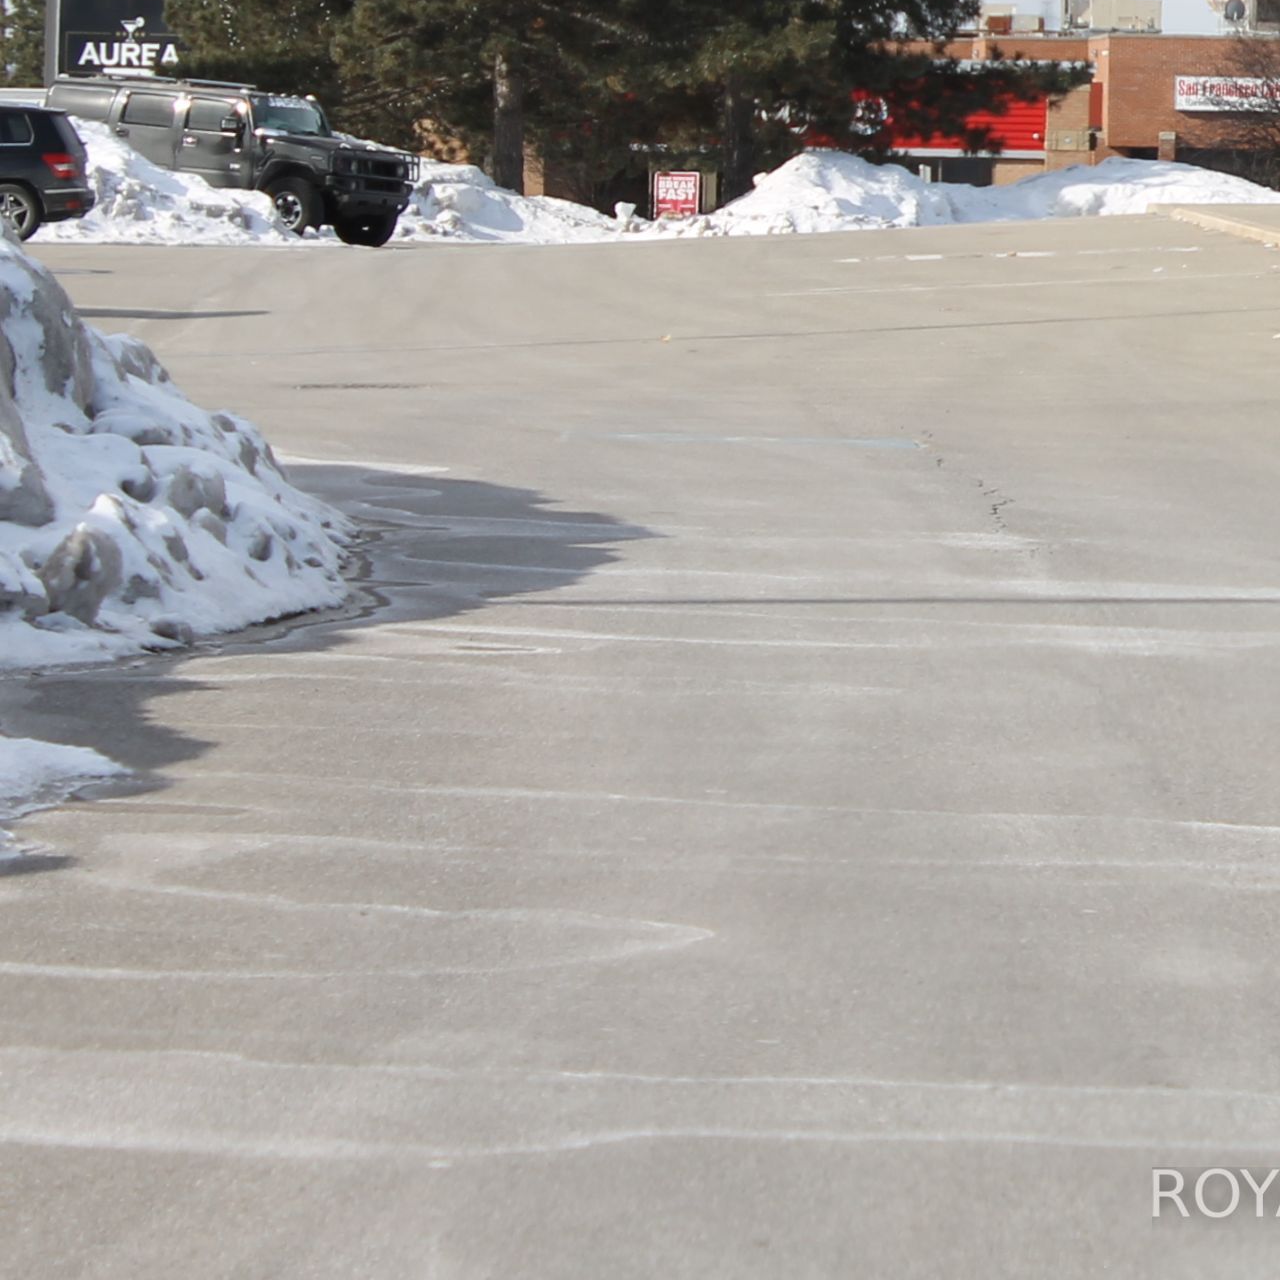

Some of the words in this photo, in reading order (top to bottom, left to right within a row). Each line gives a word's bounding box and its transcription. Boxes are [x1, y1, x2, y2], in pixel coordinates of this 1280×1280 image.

[1179, 80, 1198, 96] San
[659, 180, 696, 189] BREAK
[658, 189, 696, 200] FAST
